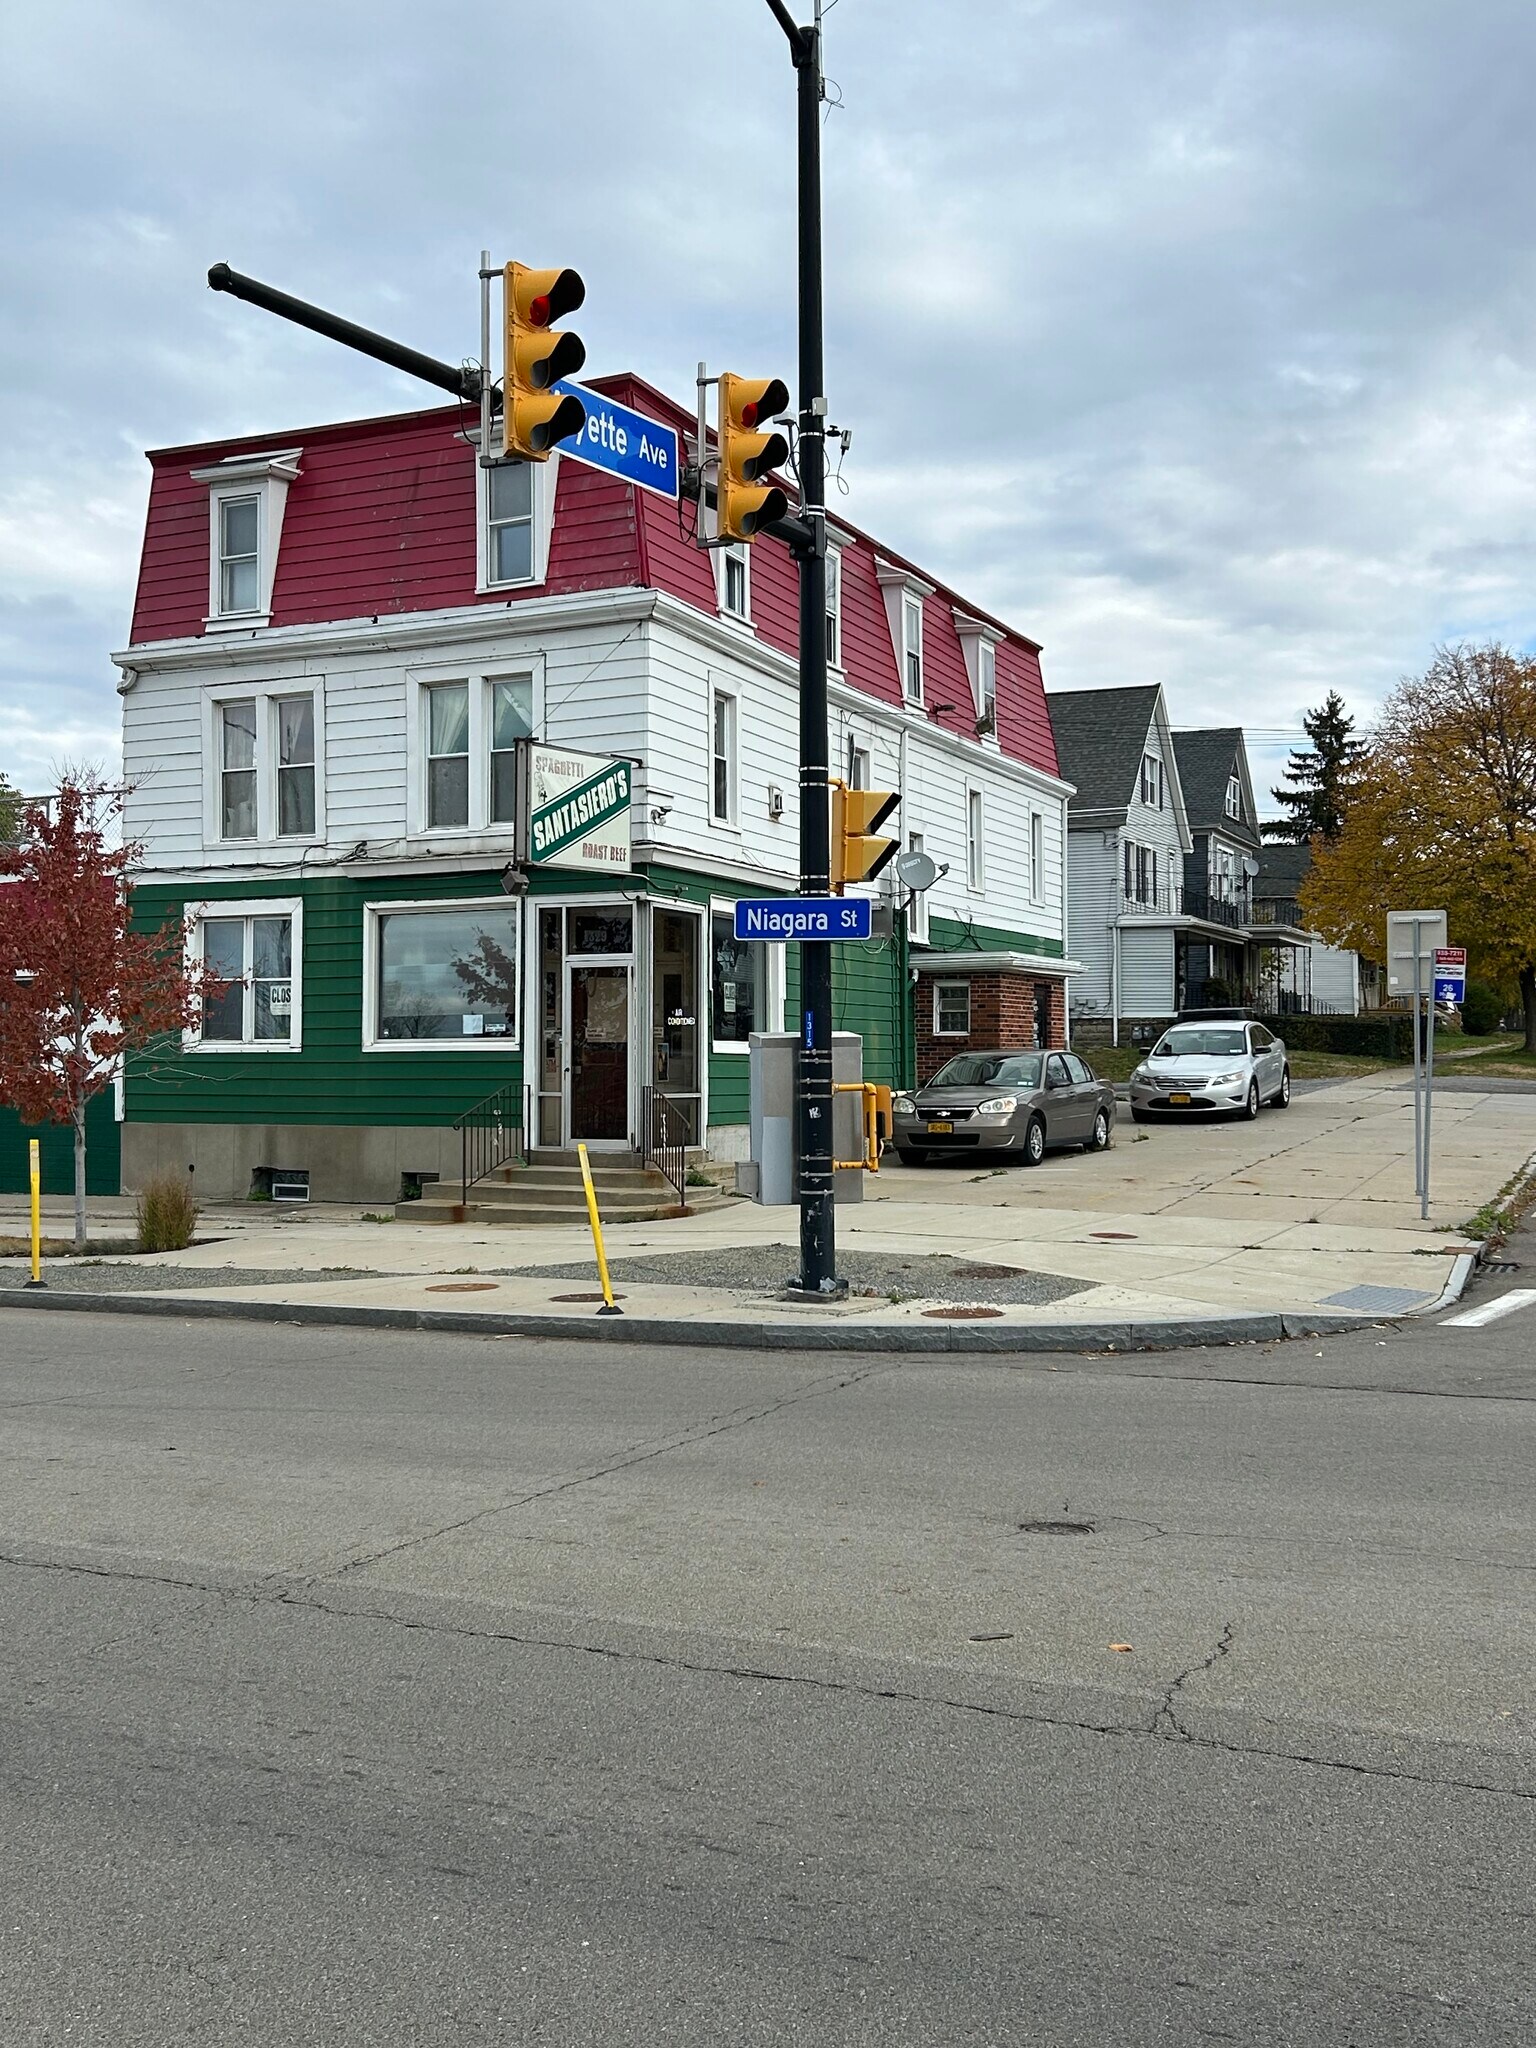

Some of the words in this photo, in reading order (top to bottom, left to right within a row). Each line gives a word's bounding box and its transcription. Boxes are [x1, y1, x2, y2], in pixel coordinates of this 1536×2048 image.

[639, 434, 668, 469] Ave
[535, 755, 584, 779] SPAGHETTI
[533, 769, 628, 851] SANTASIERO'S
[582, 842, 608, 860] ROAST
[610, 845, 627, 862] BEEF
[747, 908, 828, 938] Niagara
[840, 909, 858, 928] St
[271, 987, 291, 1004] CLOS
[1442, 984, 1454, 992] 26
